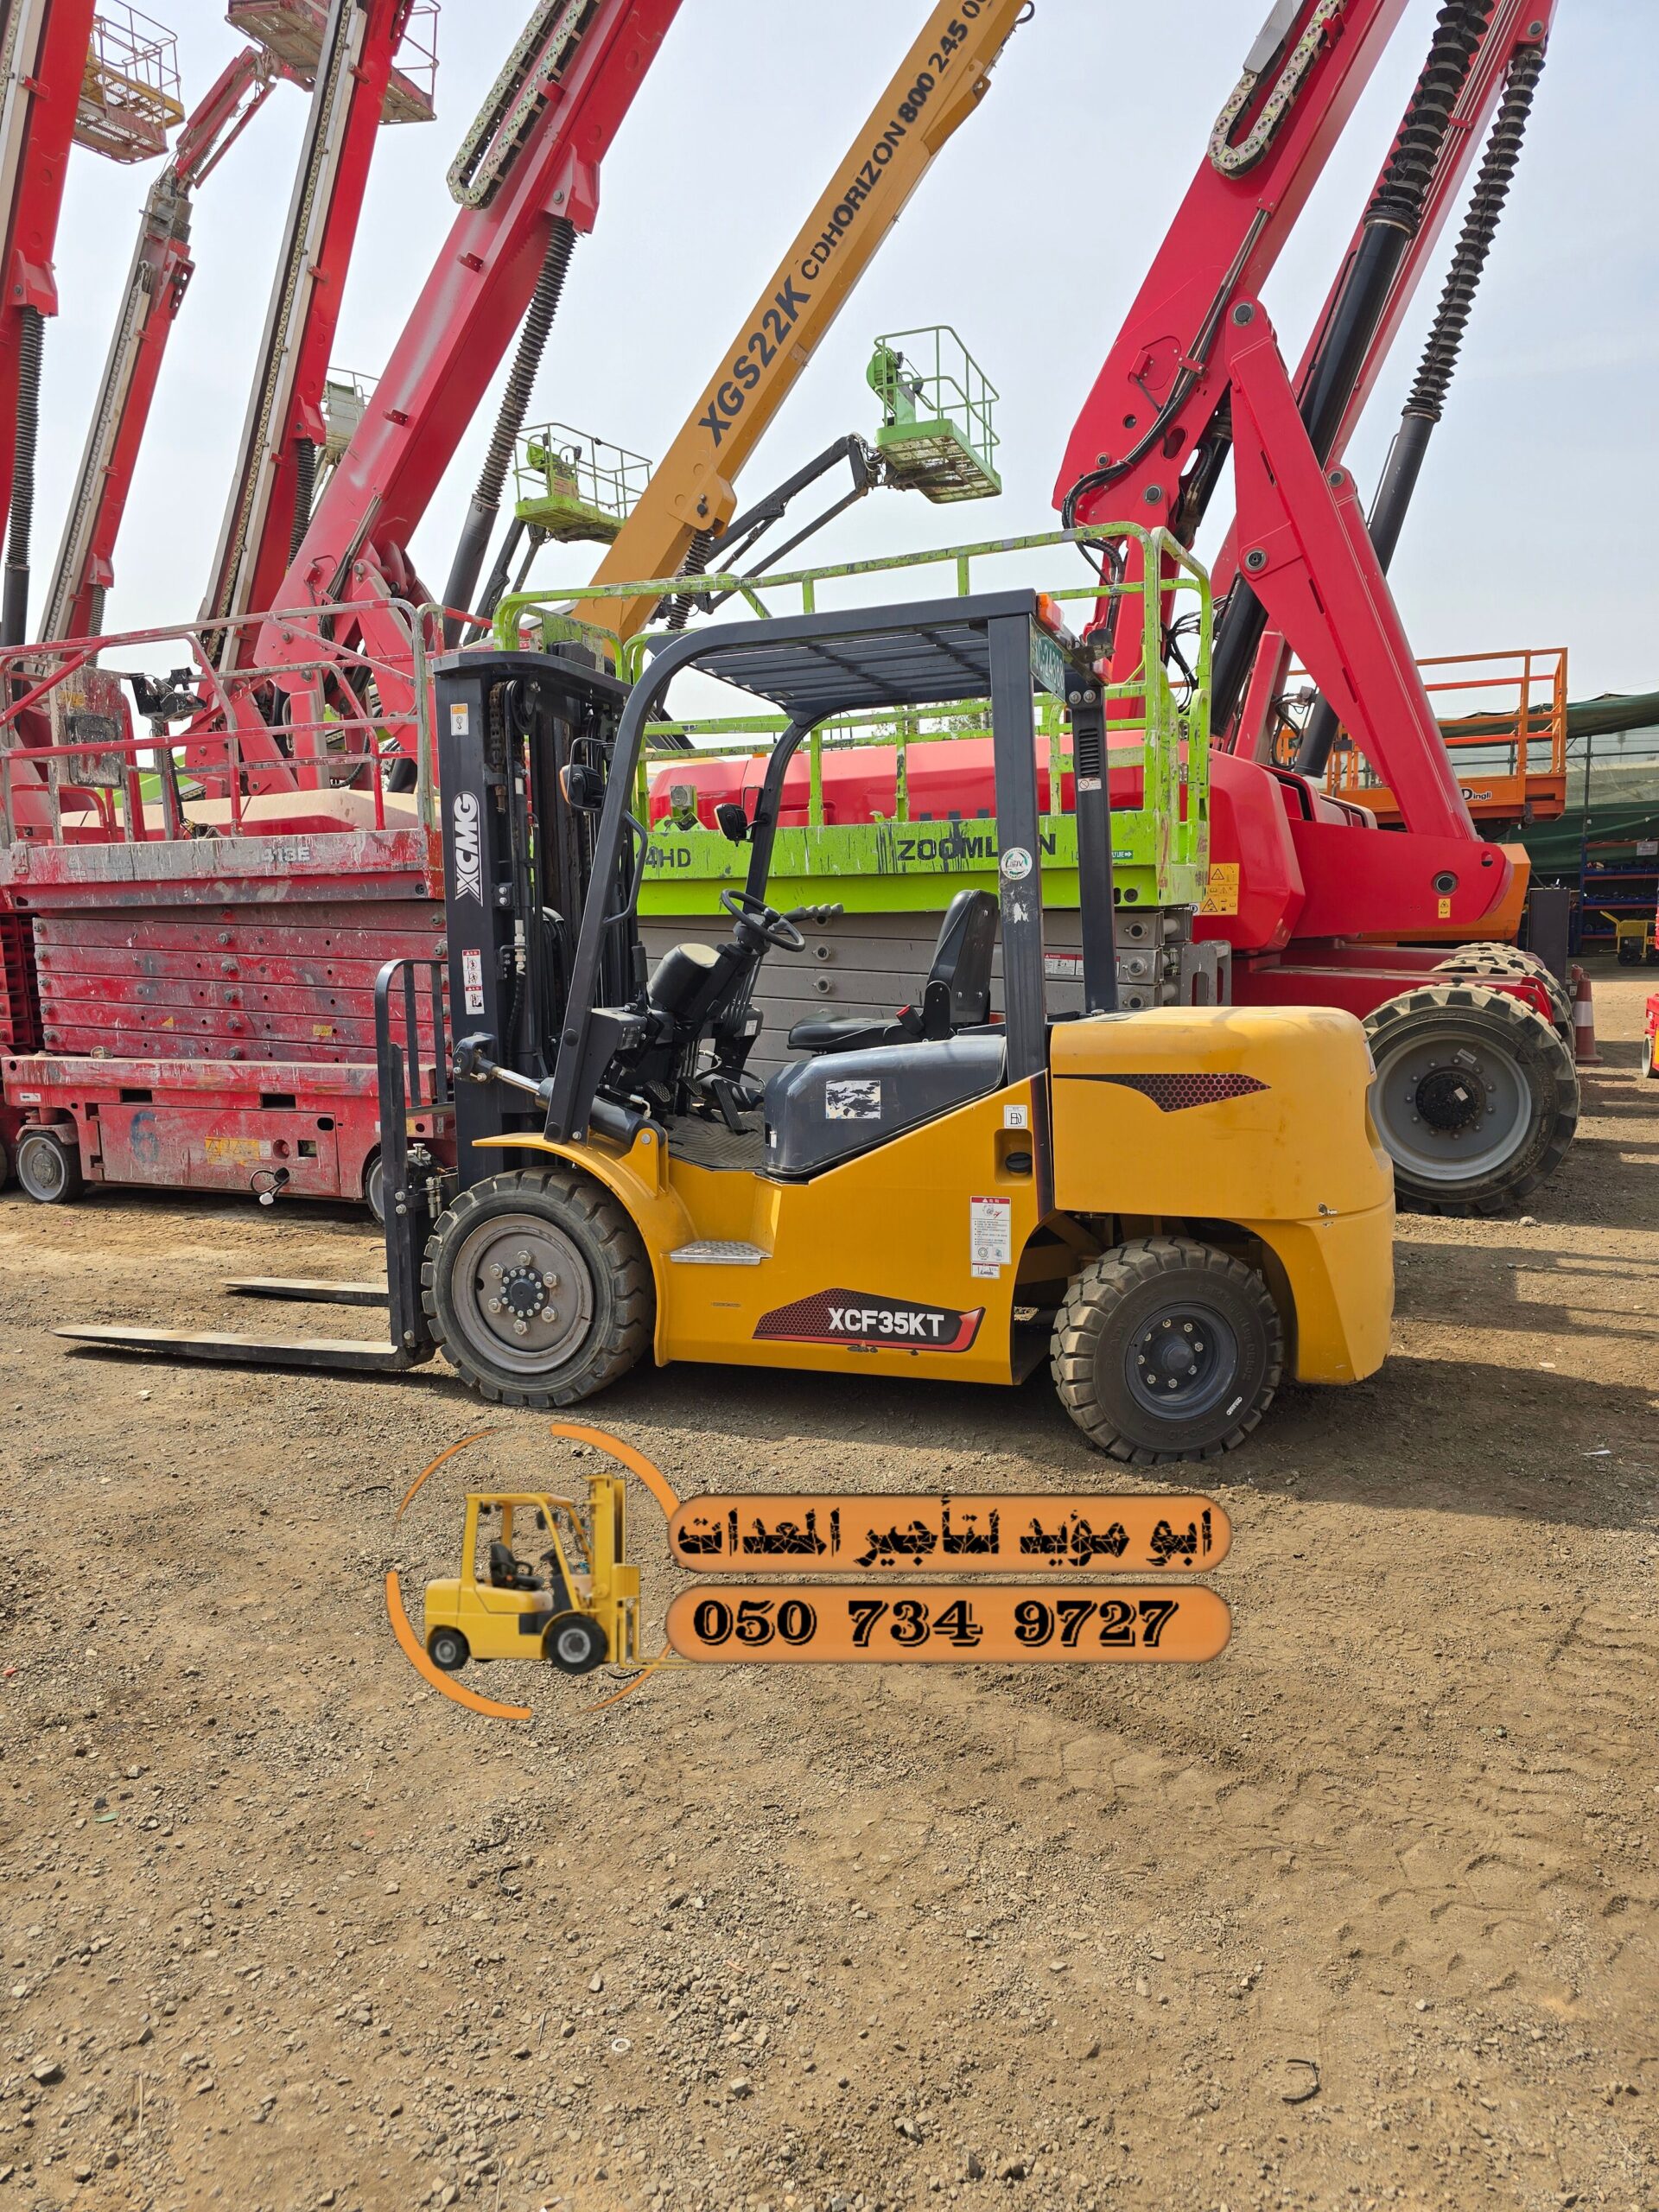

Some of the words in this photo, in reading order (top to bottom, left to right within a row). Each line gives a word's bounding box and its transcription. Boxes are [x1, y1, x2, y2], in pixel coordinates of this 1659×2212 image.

[699, 276, 810, 447] XGS22K
[898, 73, 934, 124] 800
[929, 19, 968, 73] 245
[1461, 788, 1491, 800] Dingli
[454, 793, 481, 902] XCMG
[636, 846, 691, 868] 4HD
[898, 833, 1056, 861] ZOOMLN
[828, 1307, 944, 1338] XCF35KT
